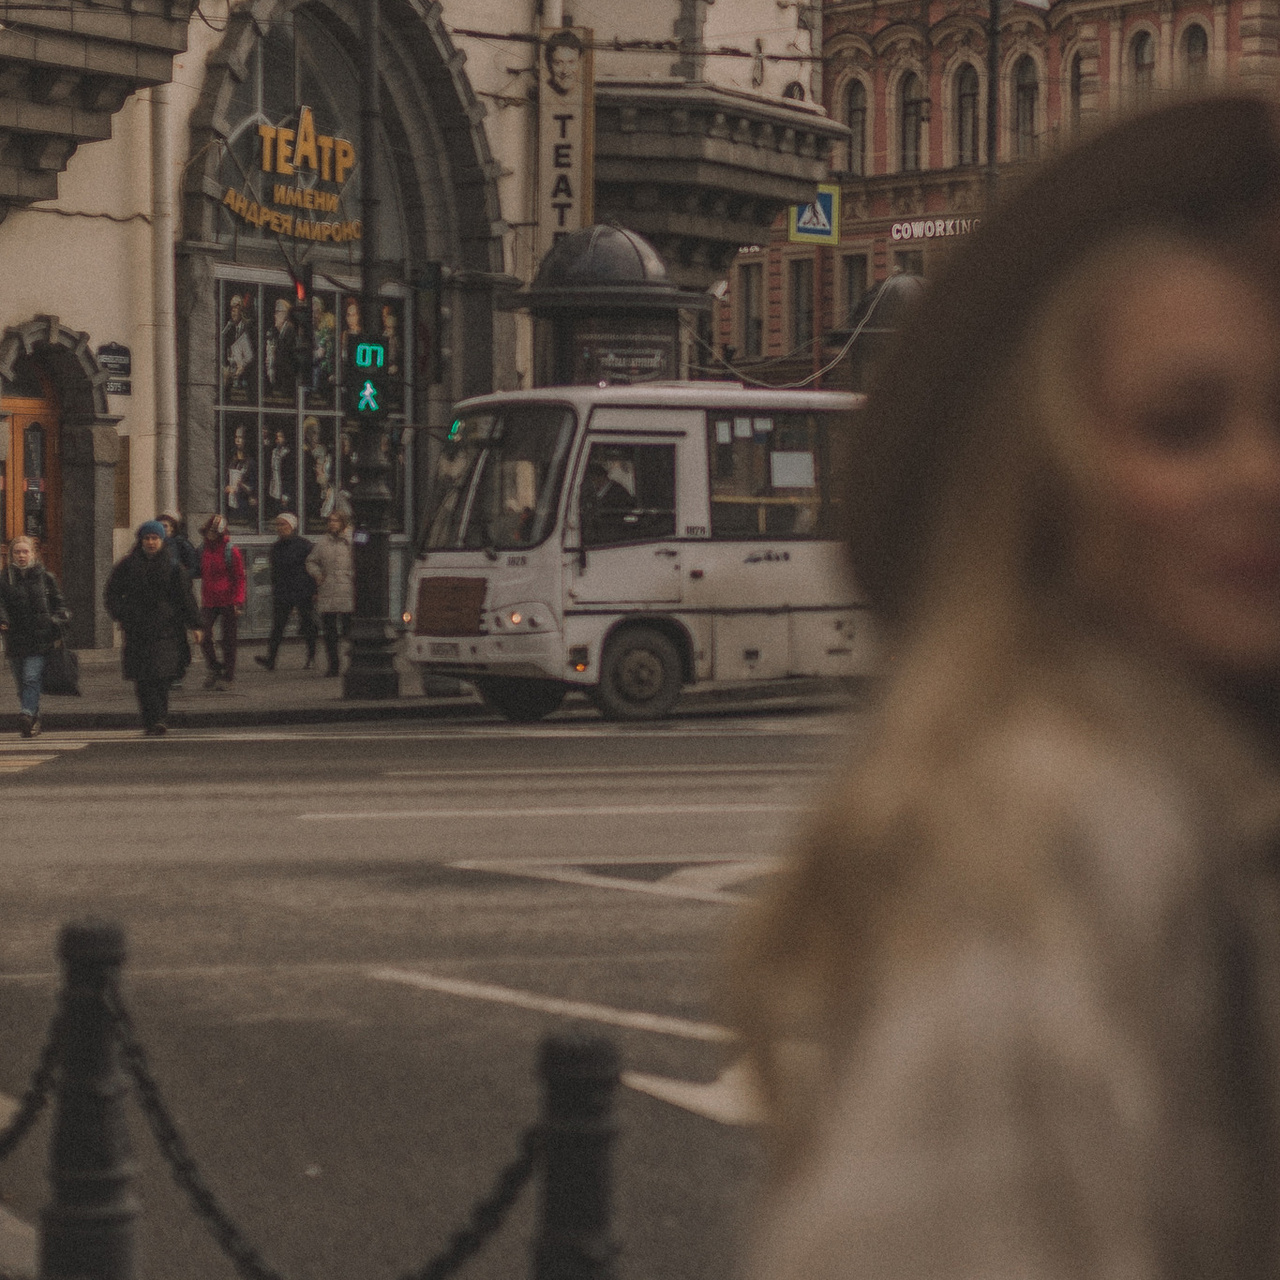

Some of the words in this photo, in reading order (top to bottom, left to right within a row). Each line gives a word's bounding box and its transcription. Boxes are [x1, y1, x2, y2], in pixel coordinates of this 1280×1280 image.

[258, 104, 356, 183] ТЕАТР
[223, 187, 293, 235] АНДРЕЯ
[295, 218, 362, 242] МИРОНО
[273, 184, 339, 213] ИМЕНИ
